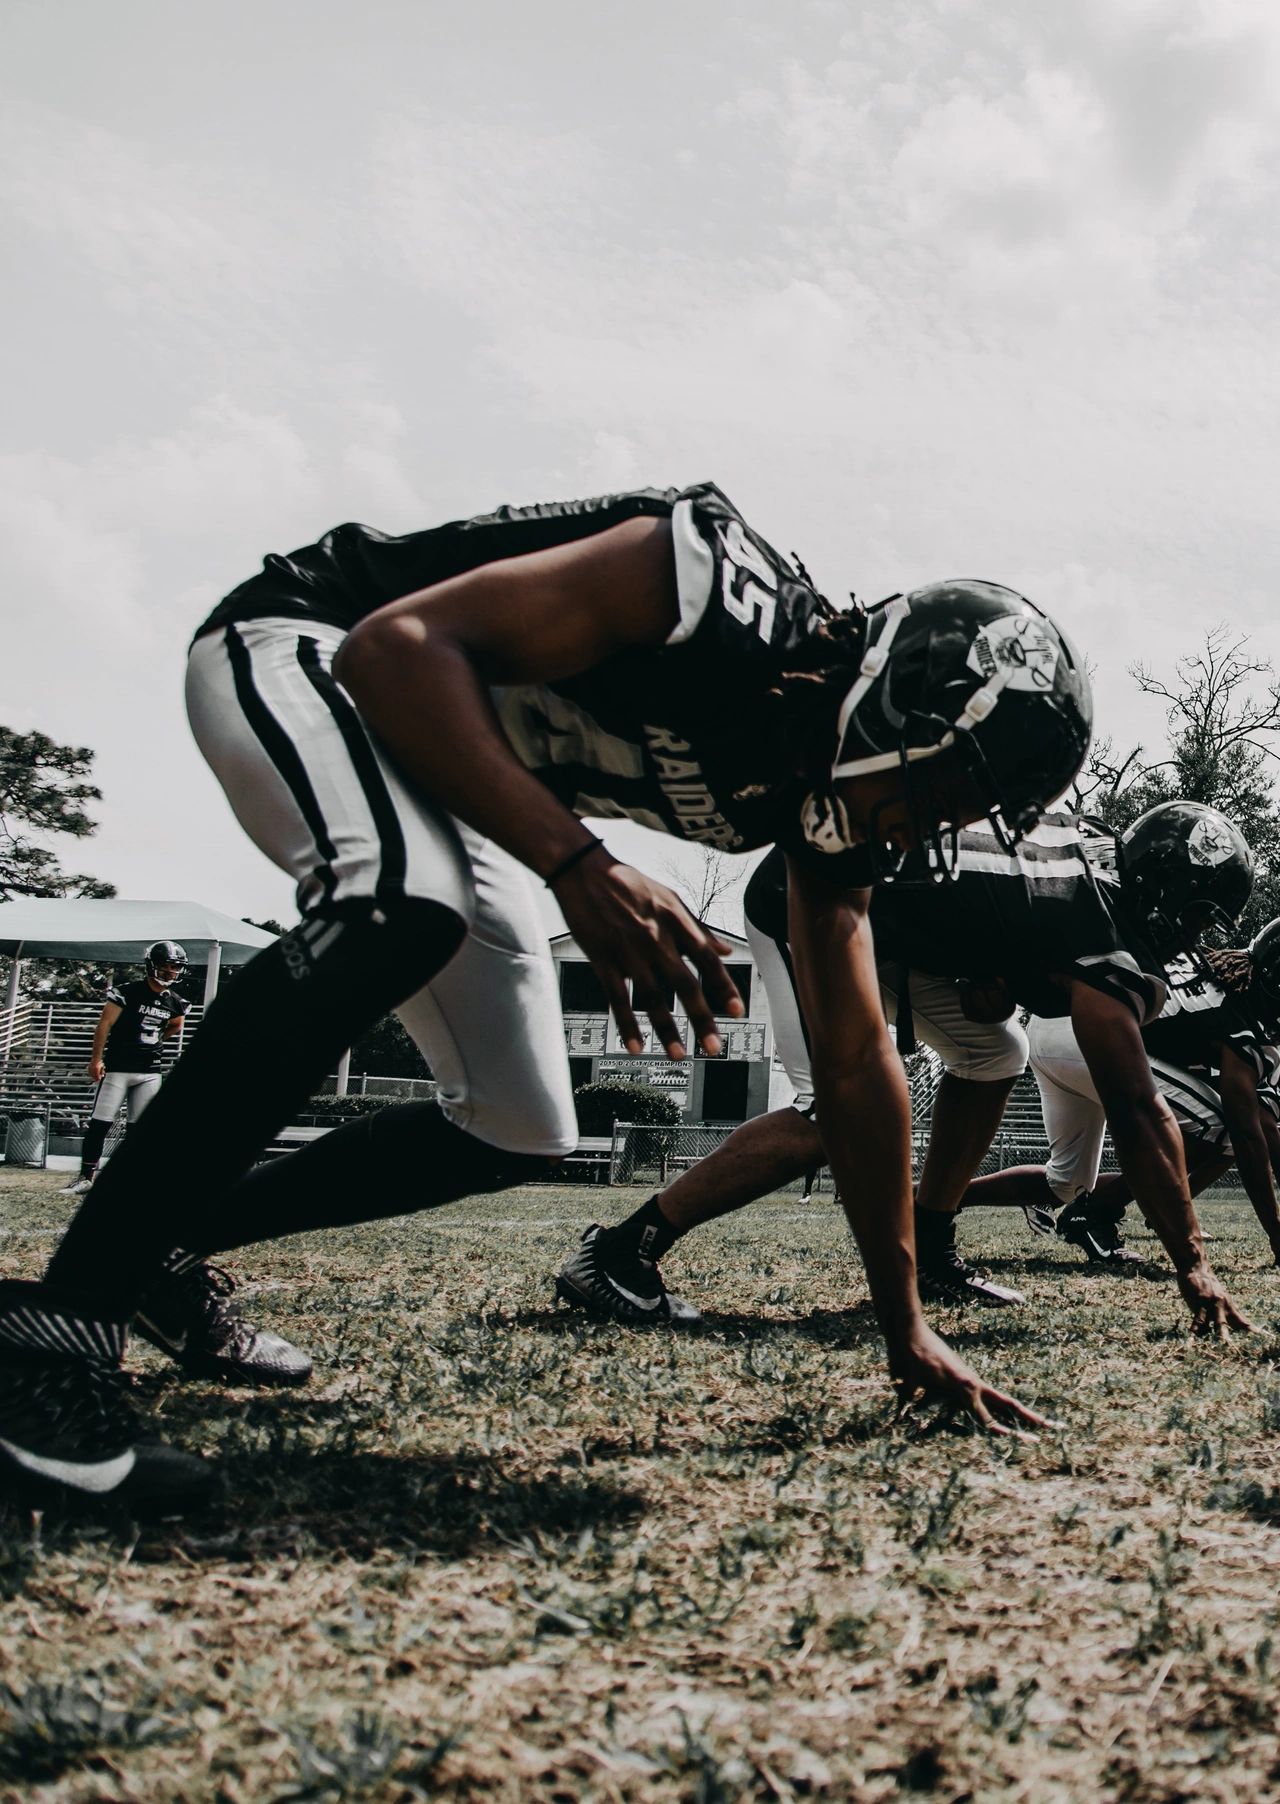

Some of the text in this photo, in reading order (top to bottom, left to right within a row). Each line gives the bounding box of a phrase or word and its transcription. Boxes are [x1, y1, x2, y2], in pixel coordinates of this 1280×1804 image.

[712, 519, 779, 646] 45
[138, 1003, 172, 1020] RAIDERS
[649, 1060, 693, 1068] CHAMPIONS
